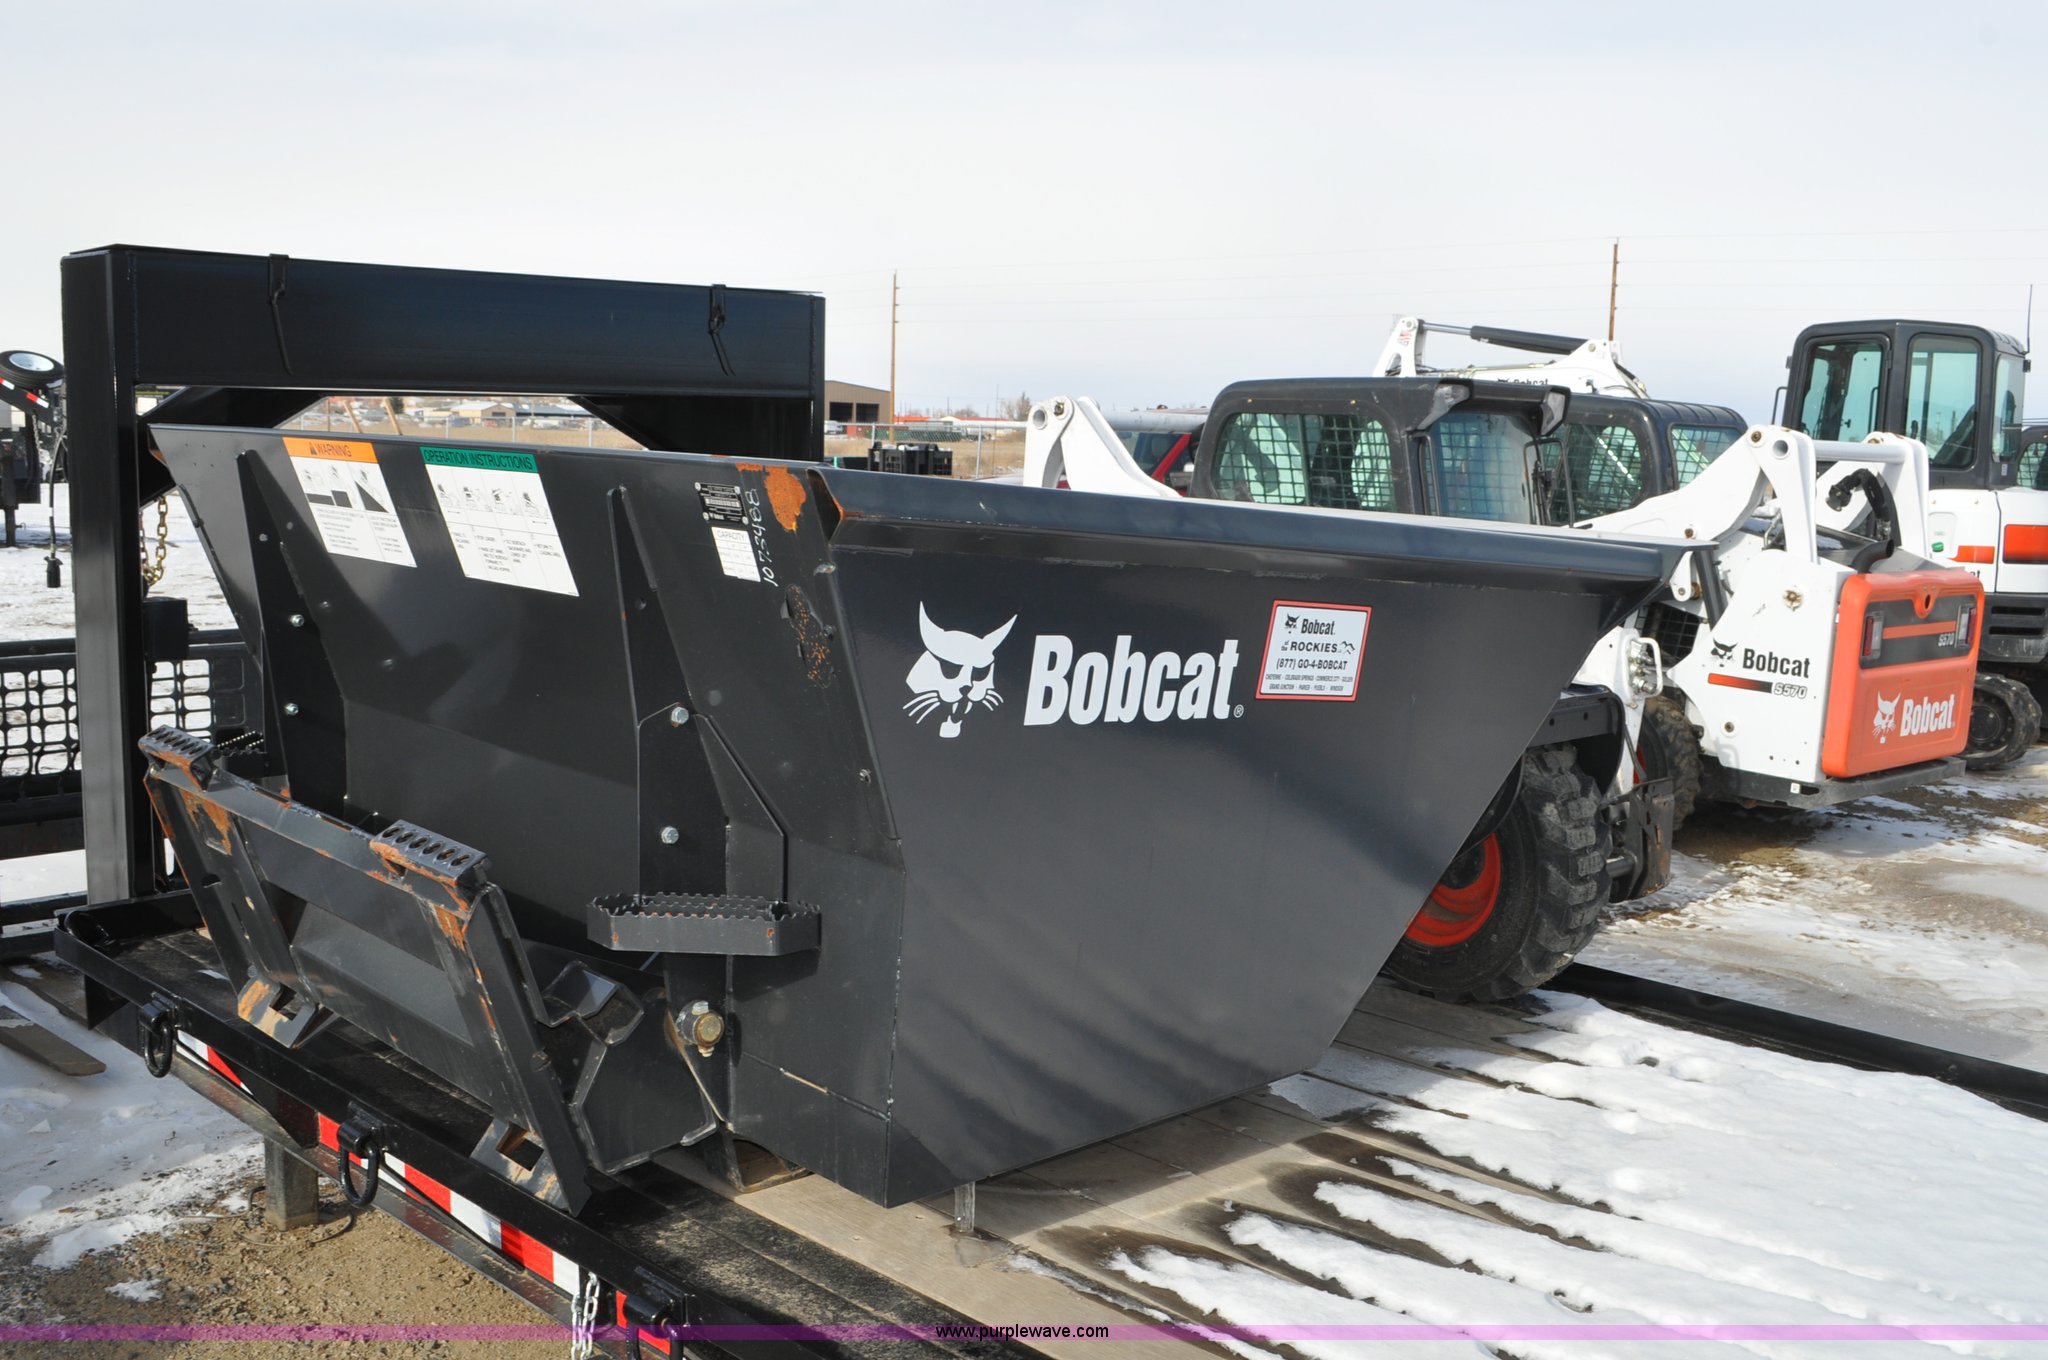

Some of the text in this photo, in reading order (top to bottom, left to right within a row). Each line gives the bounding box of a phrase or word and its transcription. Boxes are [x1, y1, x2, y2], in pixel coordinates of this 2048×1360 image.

[1513, 378, 1549, 386] bcat
[317, 443, 352, 457] WARNING
[423, 450, 533, 470] OPERATION INSTRUCTIONS
[716, 530, 745, 541] CAPACITY
[1300, 618, 1335, 635] Bobcat
[1290, 641, 1338, 653] ROCKIES
[1938, 632, 1955, 647] S570
[1276, 658, 1348, 670] (877) GO-4-BOBCAT
[1742, 648, 1810, 678] Bobcat
[1773, 682, 1808, 699] S570
[1899, 694, 1955, 737] Bobcat
